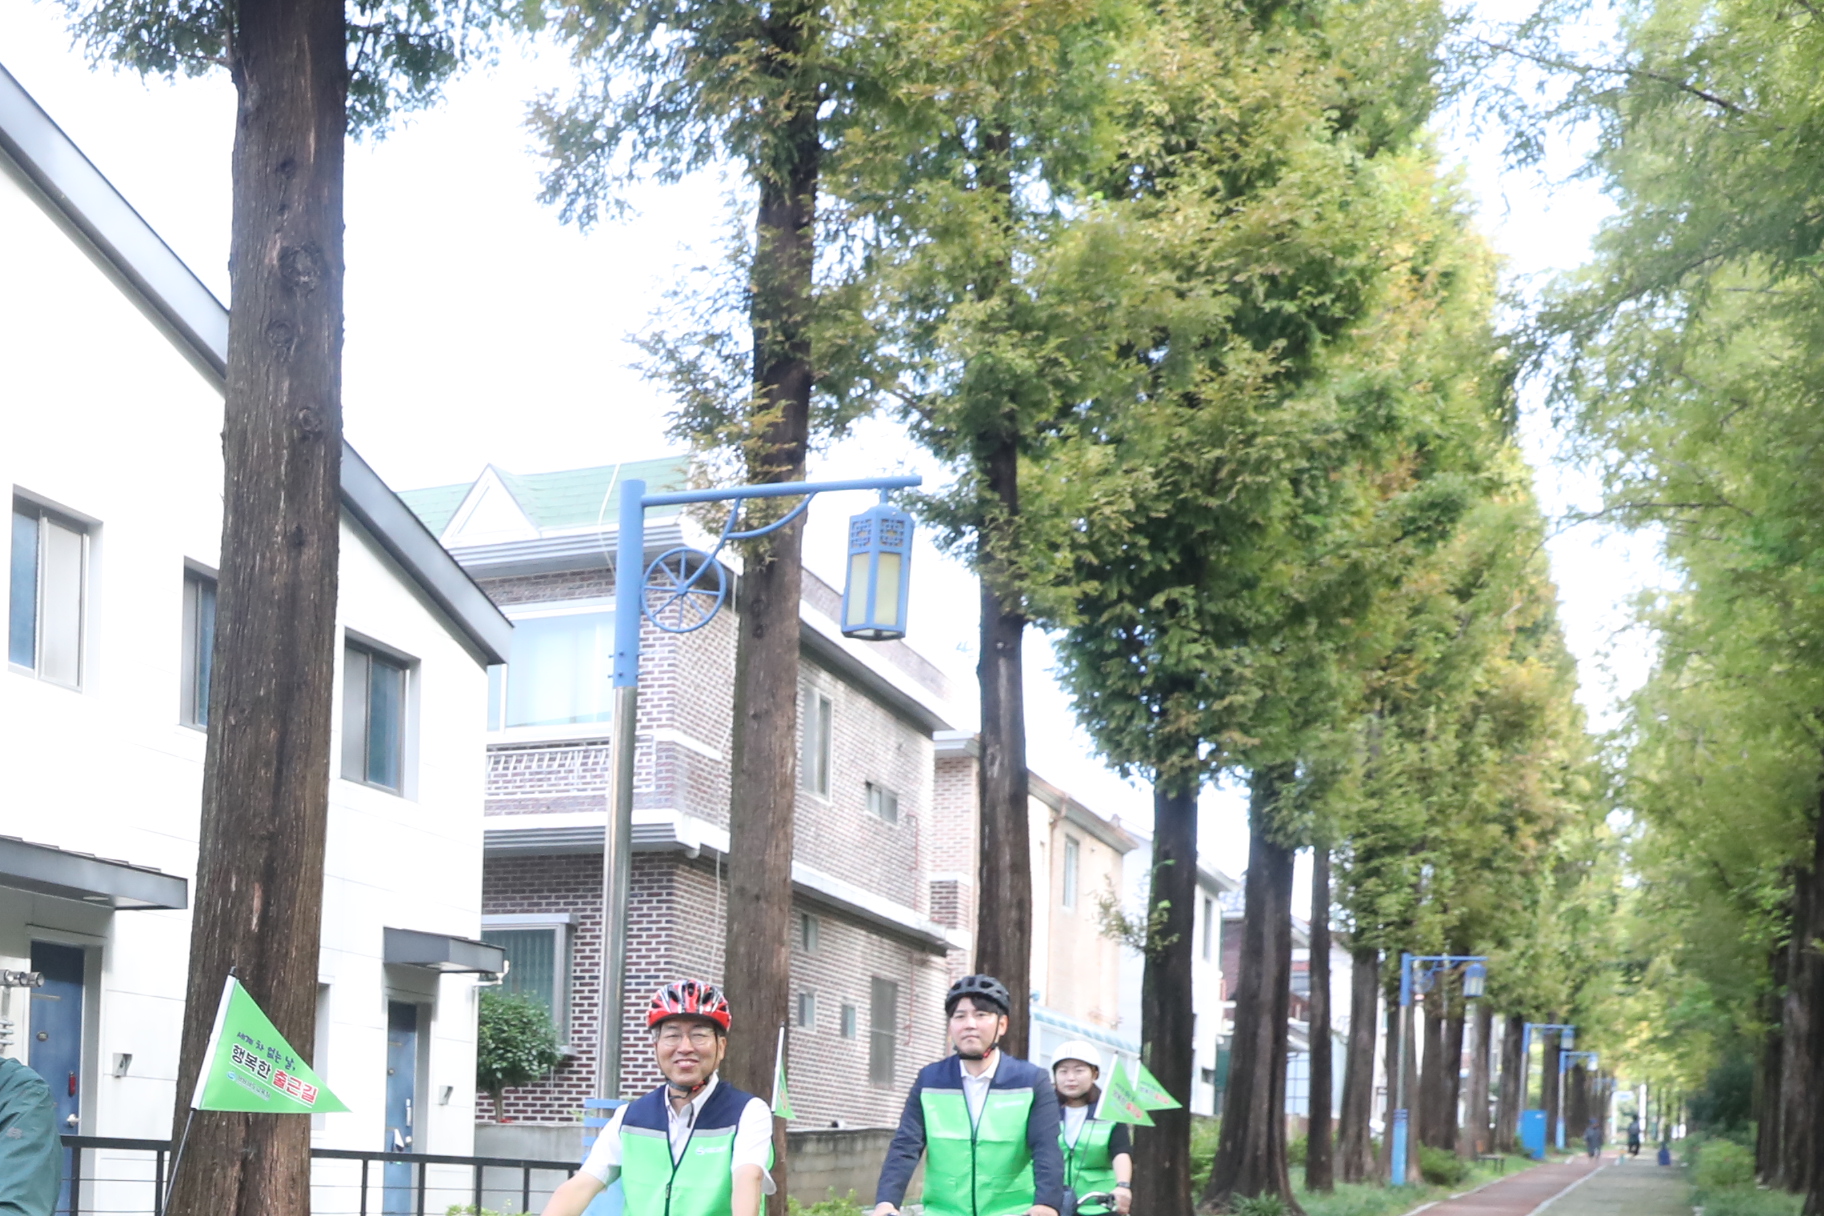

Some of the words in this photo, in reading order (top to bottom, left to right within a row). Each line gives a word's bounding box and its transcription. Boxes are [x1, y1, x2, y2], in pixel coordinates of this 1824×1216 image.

[232, 1045, 271, 1079] 행복한
[273, 1069, 317, 1104] 출근길
[237, 1032, 254, 1046] 세계
[255, 1040, 264, 1051] 차
[267, 1047, 282, 1064] 없는
[285, 1056, 296, 1071] 날,
